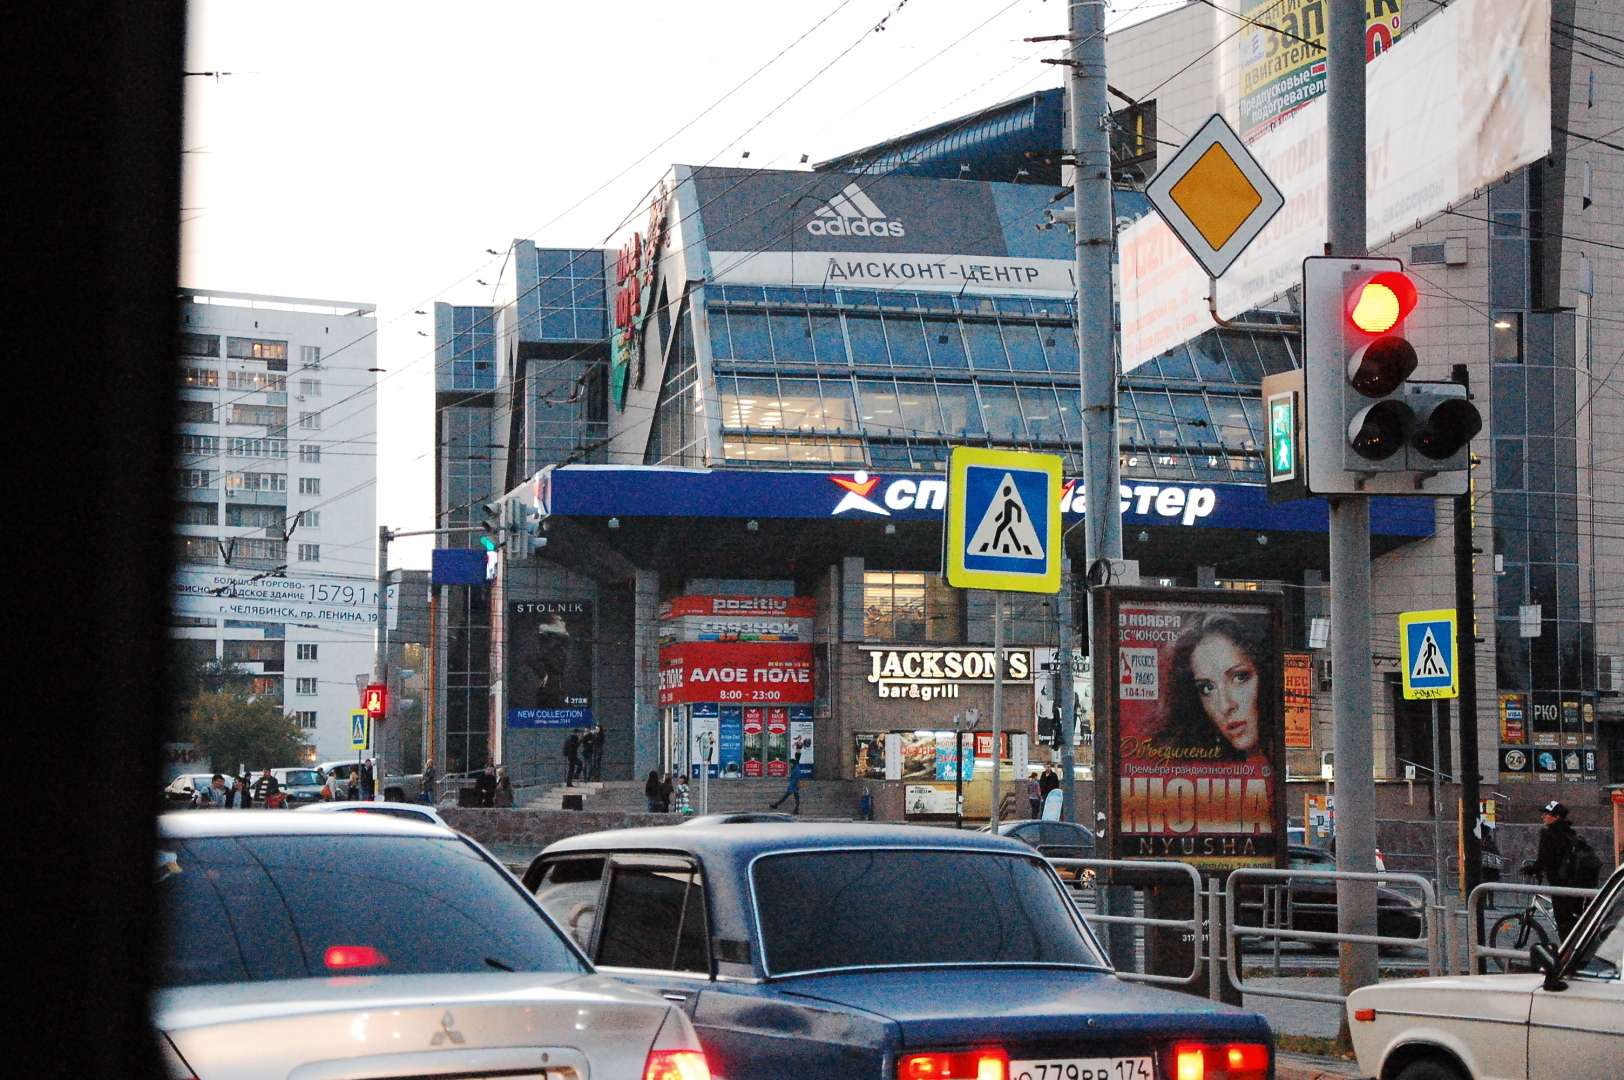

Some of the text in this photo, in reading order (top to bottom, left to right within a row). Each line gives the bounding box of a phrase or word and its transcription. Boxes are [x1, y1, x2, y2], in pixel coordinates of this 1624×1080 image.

[1244, 37, 1322, 92] двигателя
[1240, 69, 1310, 116] Предпусковые
[1383, 177, 1444, 224] аксессуары
[806, 215, 905, 237] adidas
[829, 261, 1039, 284] ДИСКОНТ-ЦЕНТР
[213, 576, 305, 589] БОЛЬШОЕ ТОРГОВО-
[269, 590, 305, 600] ЗДАНИЕ
[309, 583, 366, 606] 1579,1
[230, 605, 298, 619] ЧЕЛЯБИНСК,
[300, 610, 316, 620] пр.
[318, 610, 365, 622] ЛЕНИНА,
[517, 603, 583, 613] STOLNIK
[700, 620, 799, 634] СВЯЗНОЙ
[1129, 614, 1181, 628] НОЯБРЯ
[690, 667, 810, 684] АЛОЕ ПОЛЕ
[867, 651, 1028, 683] JACKSON'S
[564, 696, 569, 705] 4
[720, 690, 742, 700] 8:00
[752, 690, 781, 701] 23:00
[878, 684, 959, 701] bar&grill
[517, 709, 583, 718] NEW COLLECTION
[1534, 704, 1558, 721] РКО
[1508, 755, 1522, 765] 24
[1124, 763, 1255, 778] Премьера грандиозного ШОУ
[1120, 777, 1273, 834] НЮША
[1139, 837, 1256, 855] NYUSHA
[1115, 1060, 1150, 1080] 174
